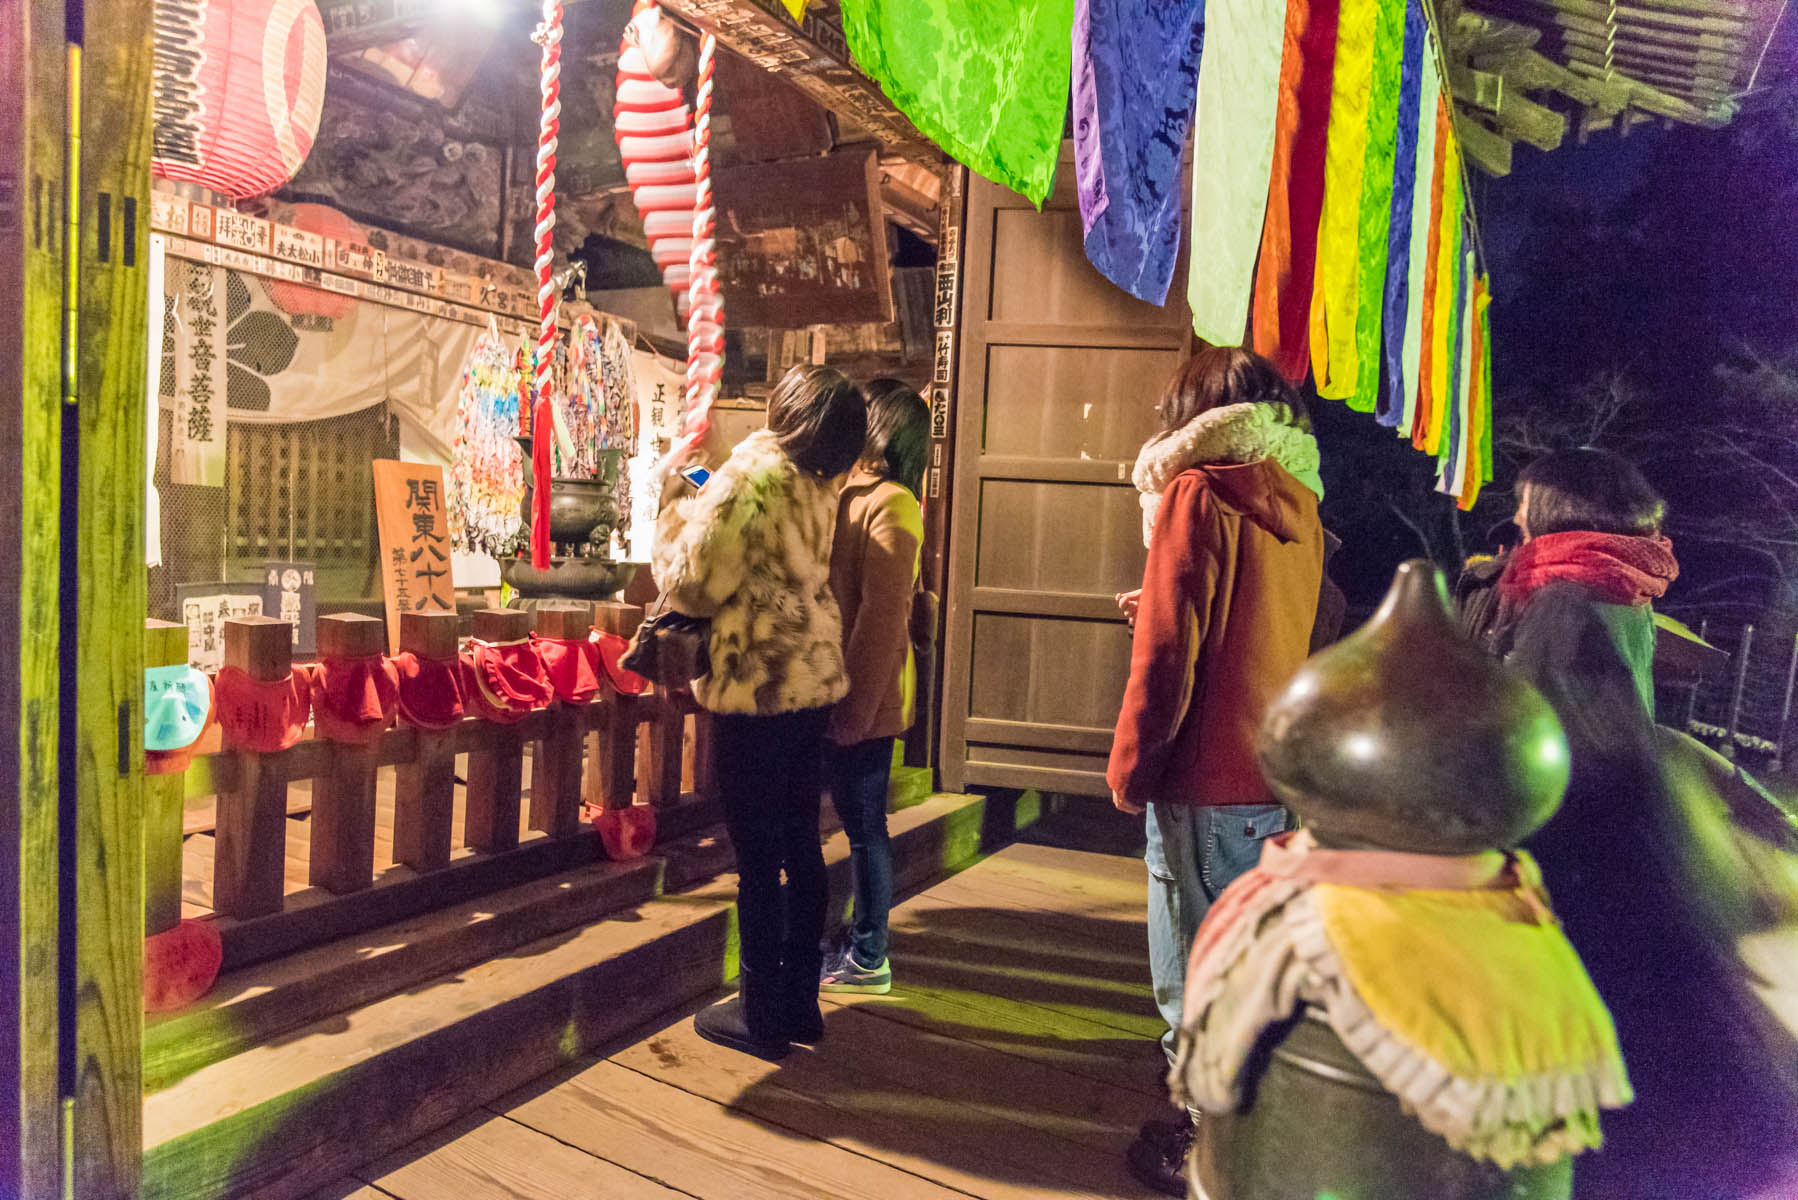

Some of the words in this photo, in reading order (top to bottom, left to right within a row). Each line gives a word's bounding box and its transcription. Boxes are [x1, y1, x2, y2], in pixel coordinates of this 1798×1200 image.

[405, 478, 453, 611] 関東八十八
